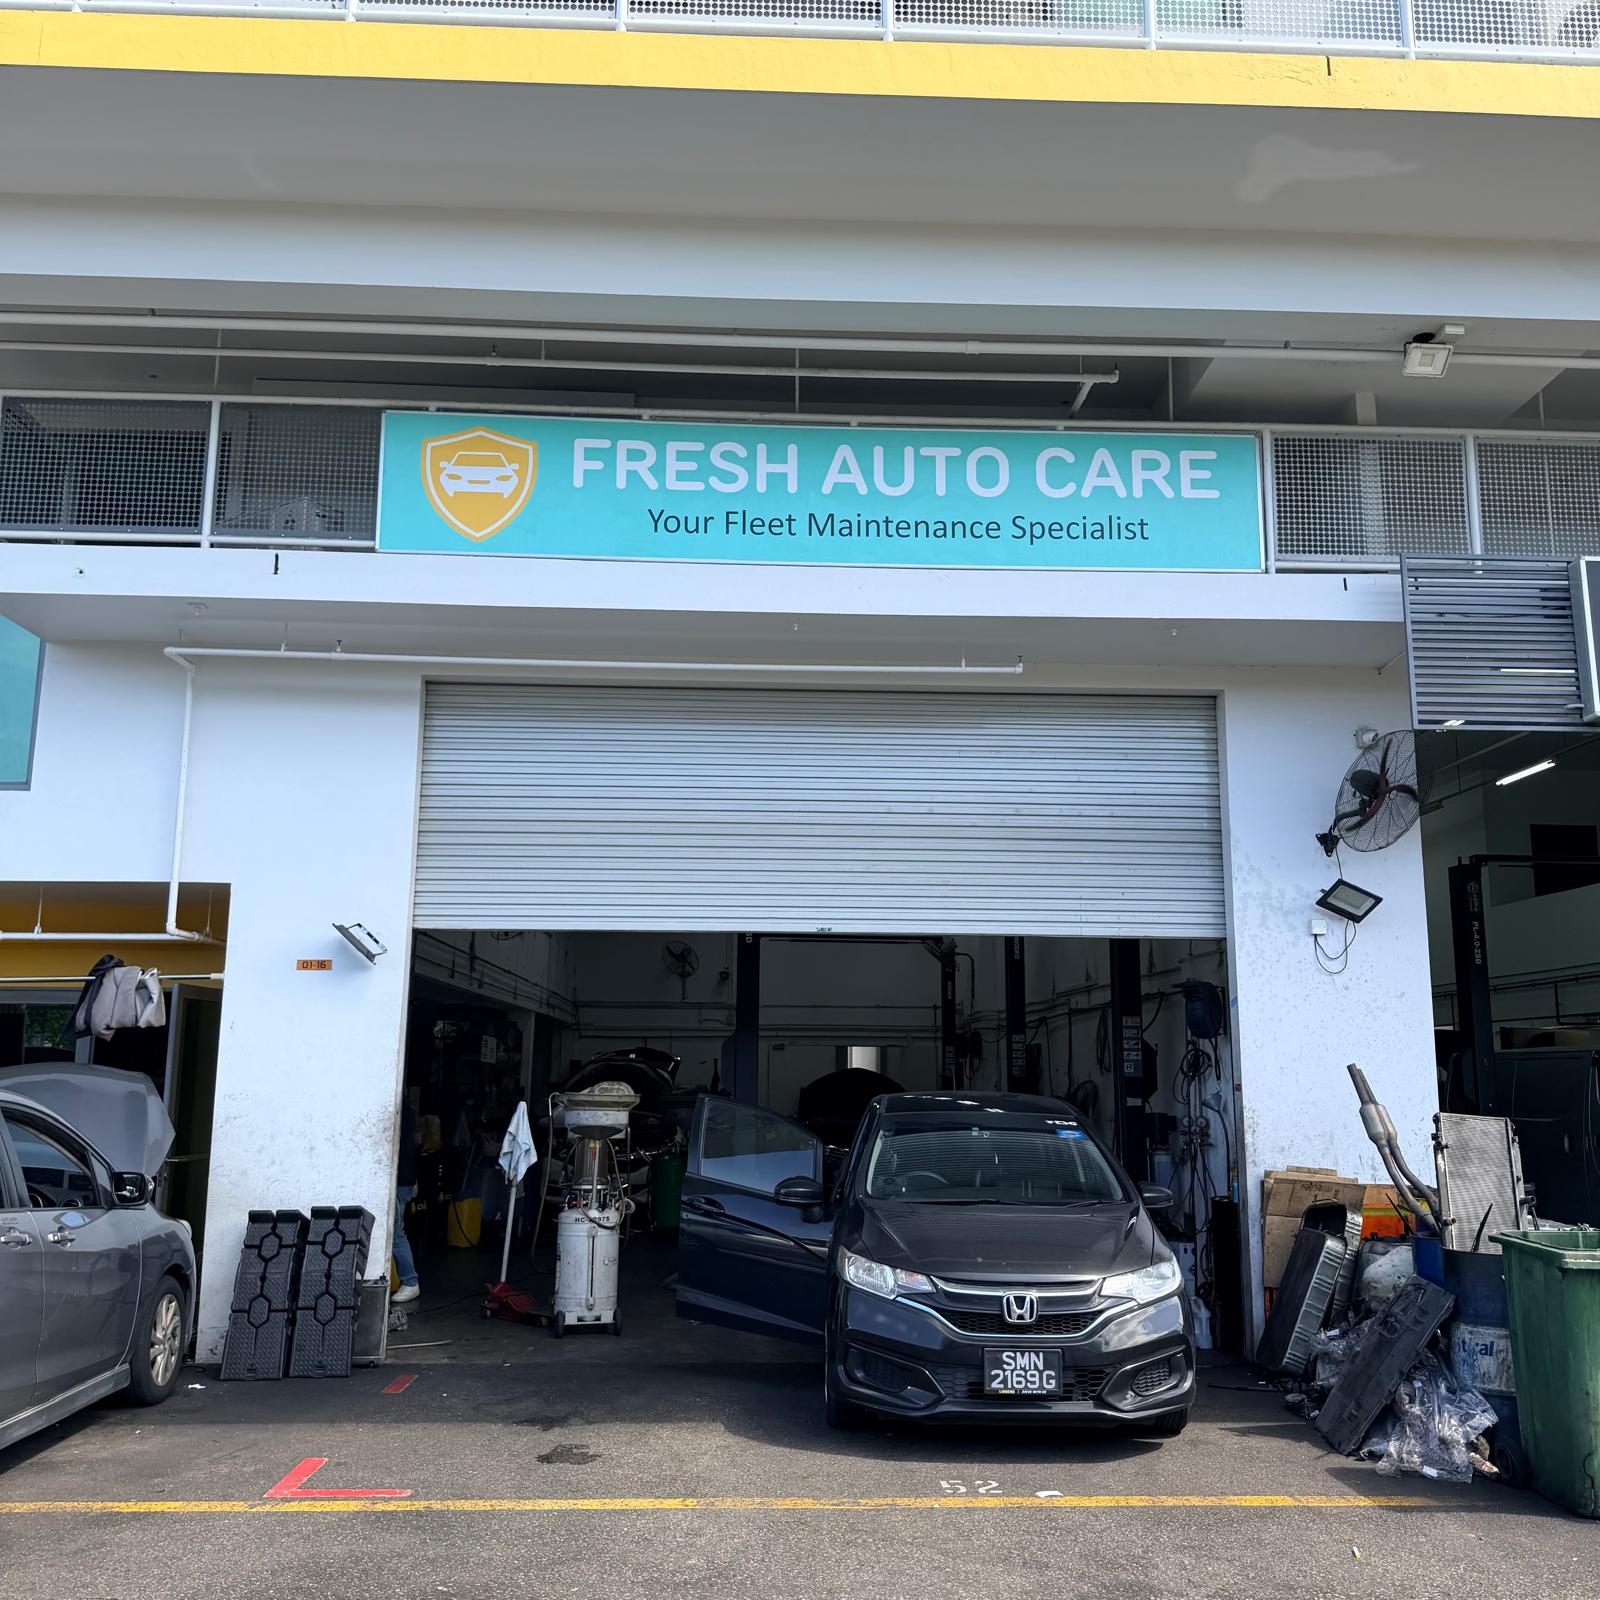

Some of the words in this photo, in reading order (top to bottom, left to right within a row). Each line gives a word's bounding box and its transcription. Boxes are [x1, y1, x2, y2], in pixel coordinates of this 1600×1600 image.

[573, 438, 798, 494] FRESH
[821, 444, 1010, 498] AUTO
[1035, 447, 1220, 499] CARE
[648, 508, 714, 535] Your
[725, 509, 797, 536] Fleet
[808, 512, 1002, 540] Maintenance
[1011, 515, 1149, 545] Specialist
[302, 960, 327, 969] 01-16
[1002, 1351, 1044, 1371] SMN
[990, 1369, 1056, 1389] 2169G
[940, 1480, 1003, 1493] 52
